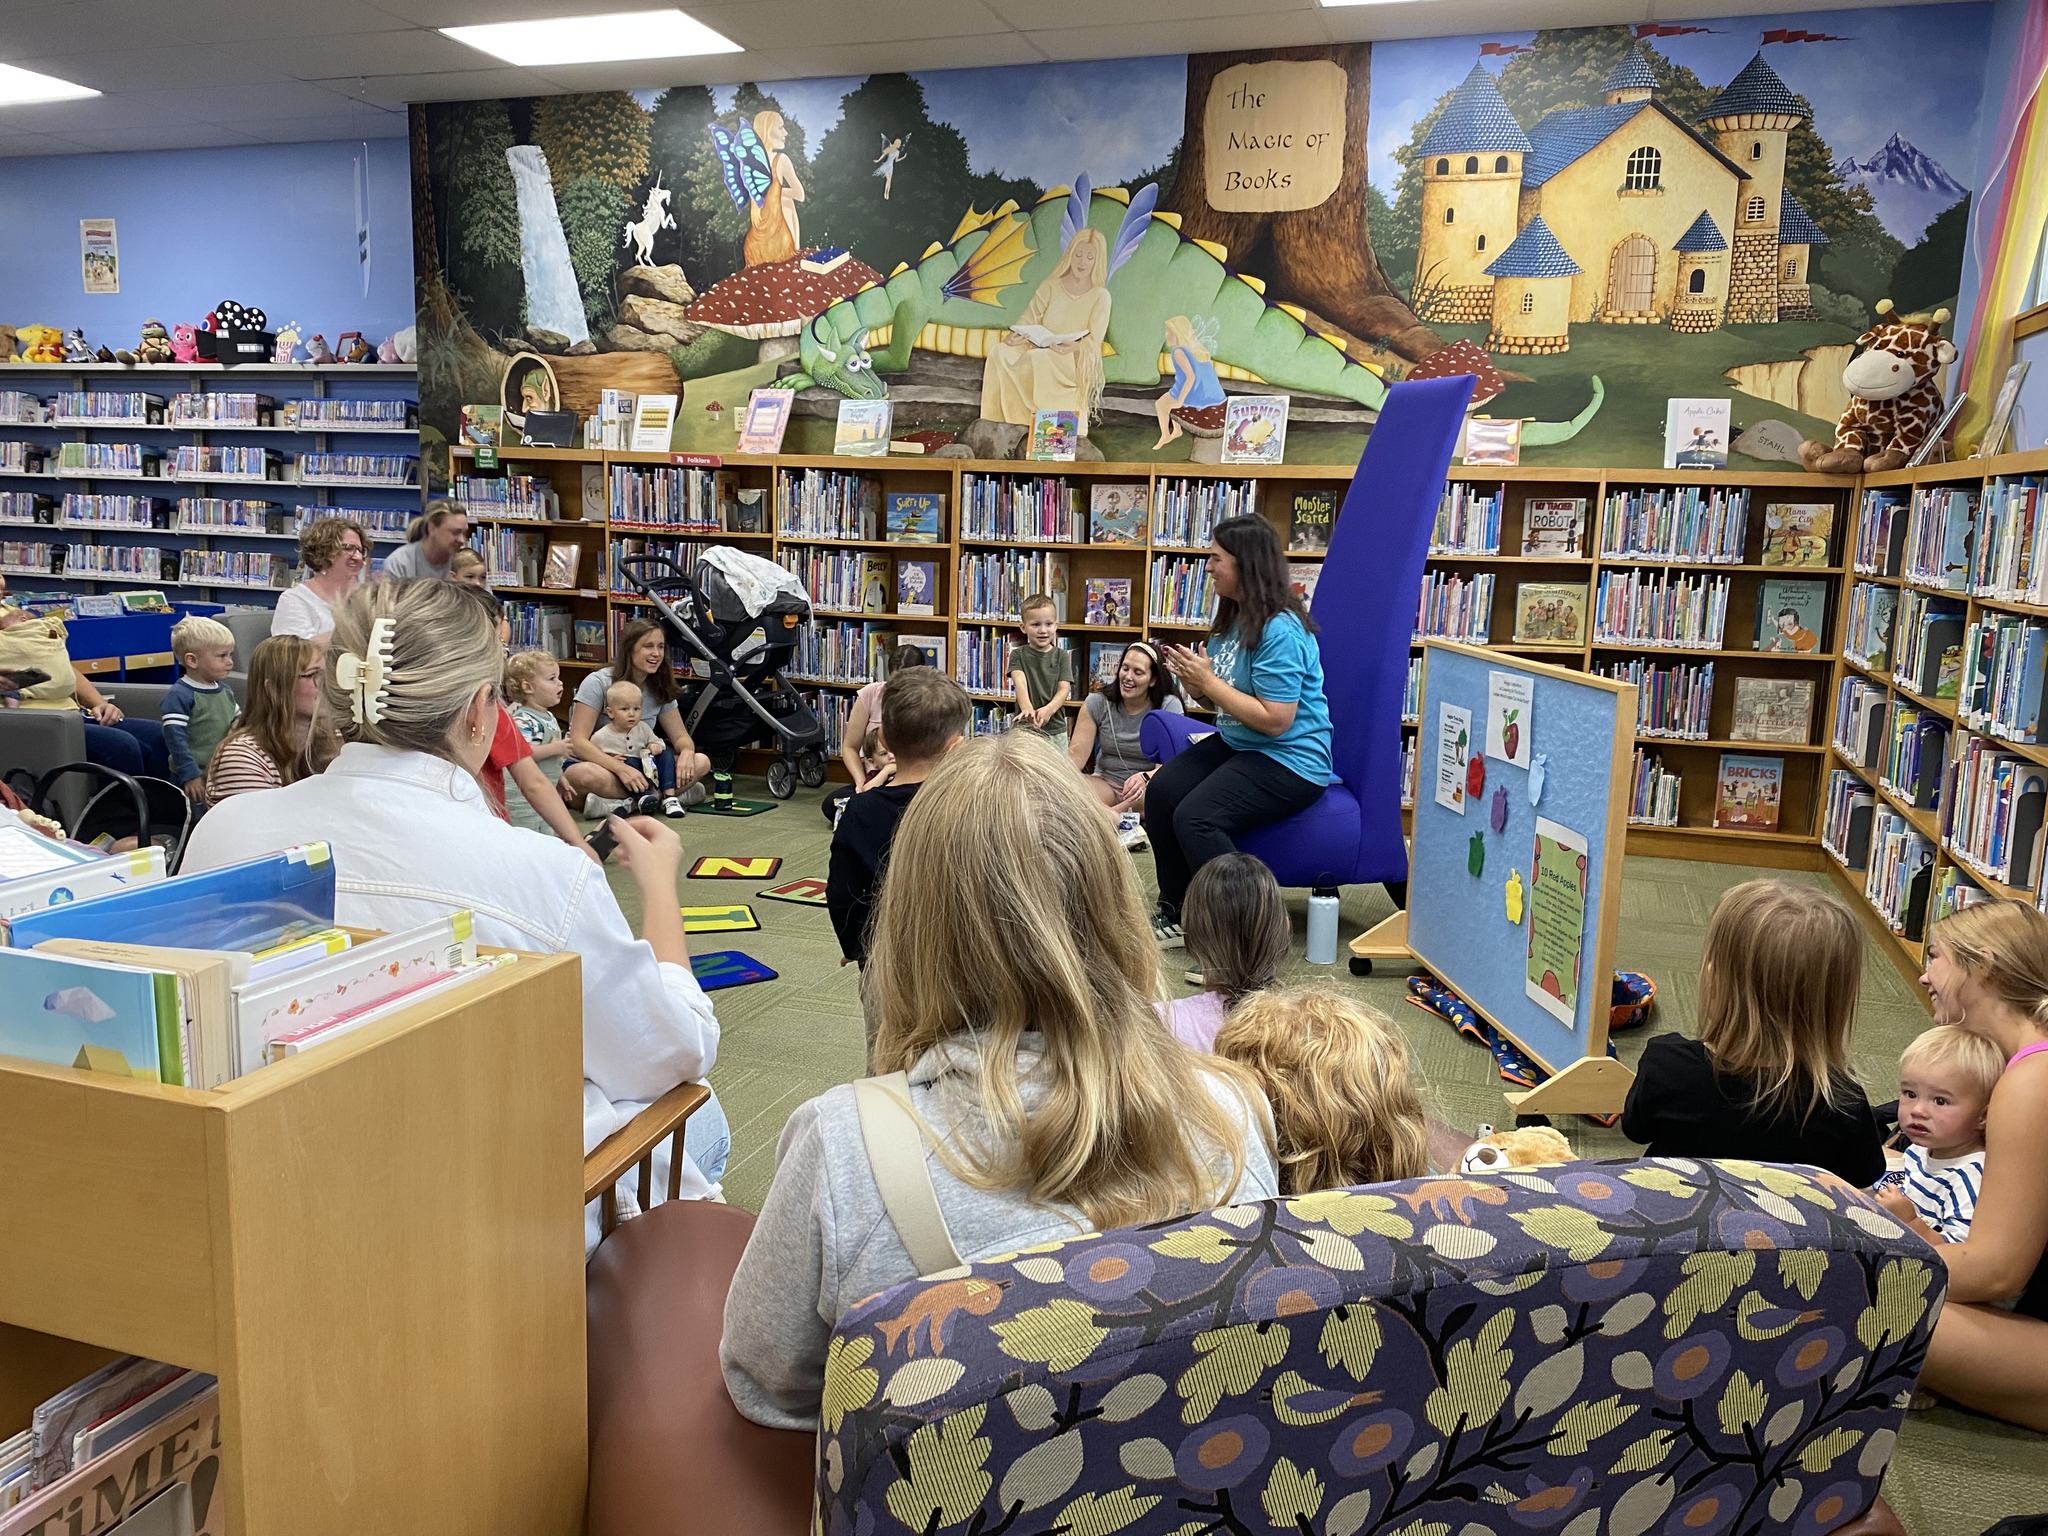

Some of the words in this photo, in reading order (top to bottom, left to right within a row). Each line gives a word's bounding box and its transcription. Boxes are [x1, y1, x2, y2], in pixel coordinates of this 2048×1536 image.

[1227, 83, 1266, 109] The
[1224, 168, 1292, 191] Books
[1233, 406, 1280, 419] TURNIP
[1758, 436, 1785, 454] STAHL
[1785, 507, 1807, 515] Nana
[1533, 515, 1572, 528] ROBOT
[1798, 516, 1814, 525] City
[867, 560, 888, 572] Betty
[1727, 766, 1777, 779] BRICKS
[1541, 866, 1548, 877] 10
[1549, 870, 1559, 882] Red
[1560, 876, 1577, 892] Apples
